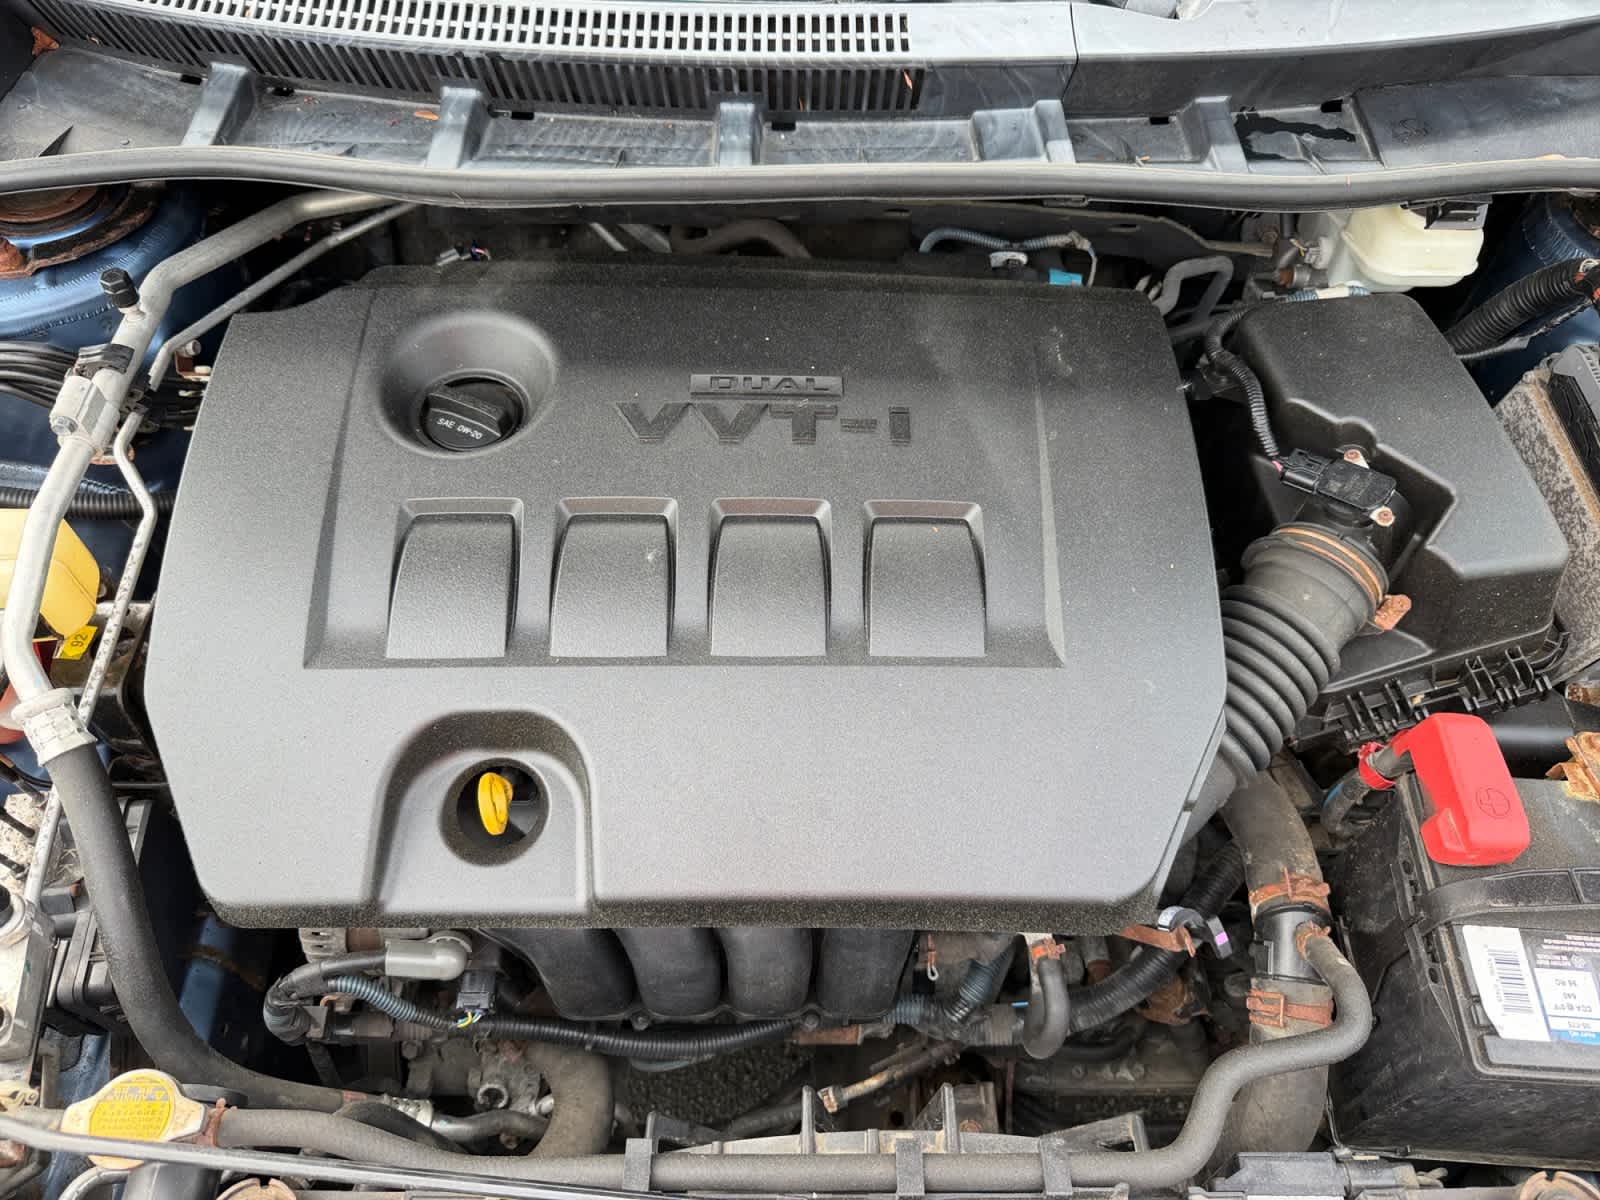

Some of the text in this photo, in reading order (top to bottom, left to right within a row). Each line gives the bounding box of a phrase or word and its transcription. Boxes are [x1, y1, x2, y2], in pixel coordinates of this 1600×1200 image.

[709, 375, 830, 391] DUAL
[436, 417, 483, 440] SAE 0W-20
